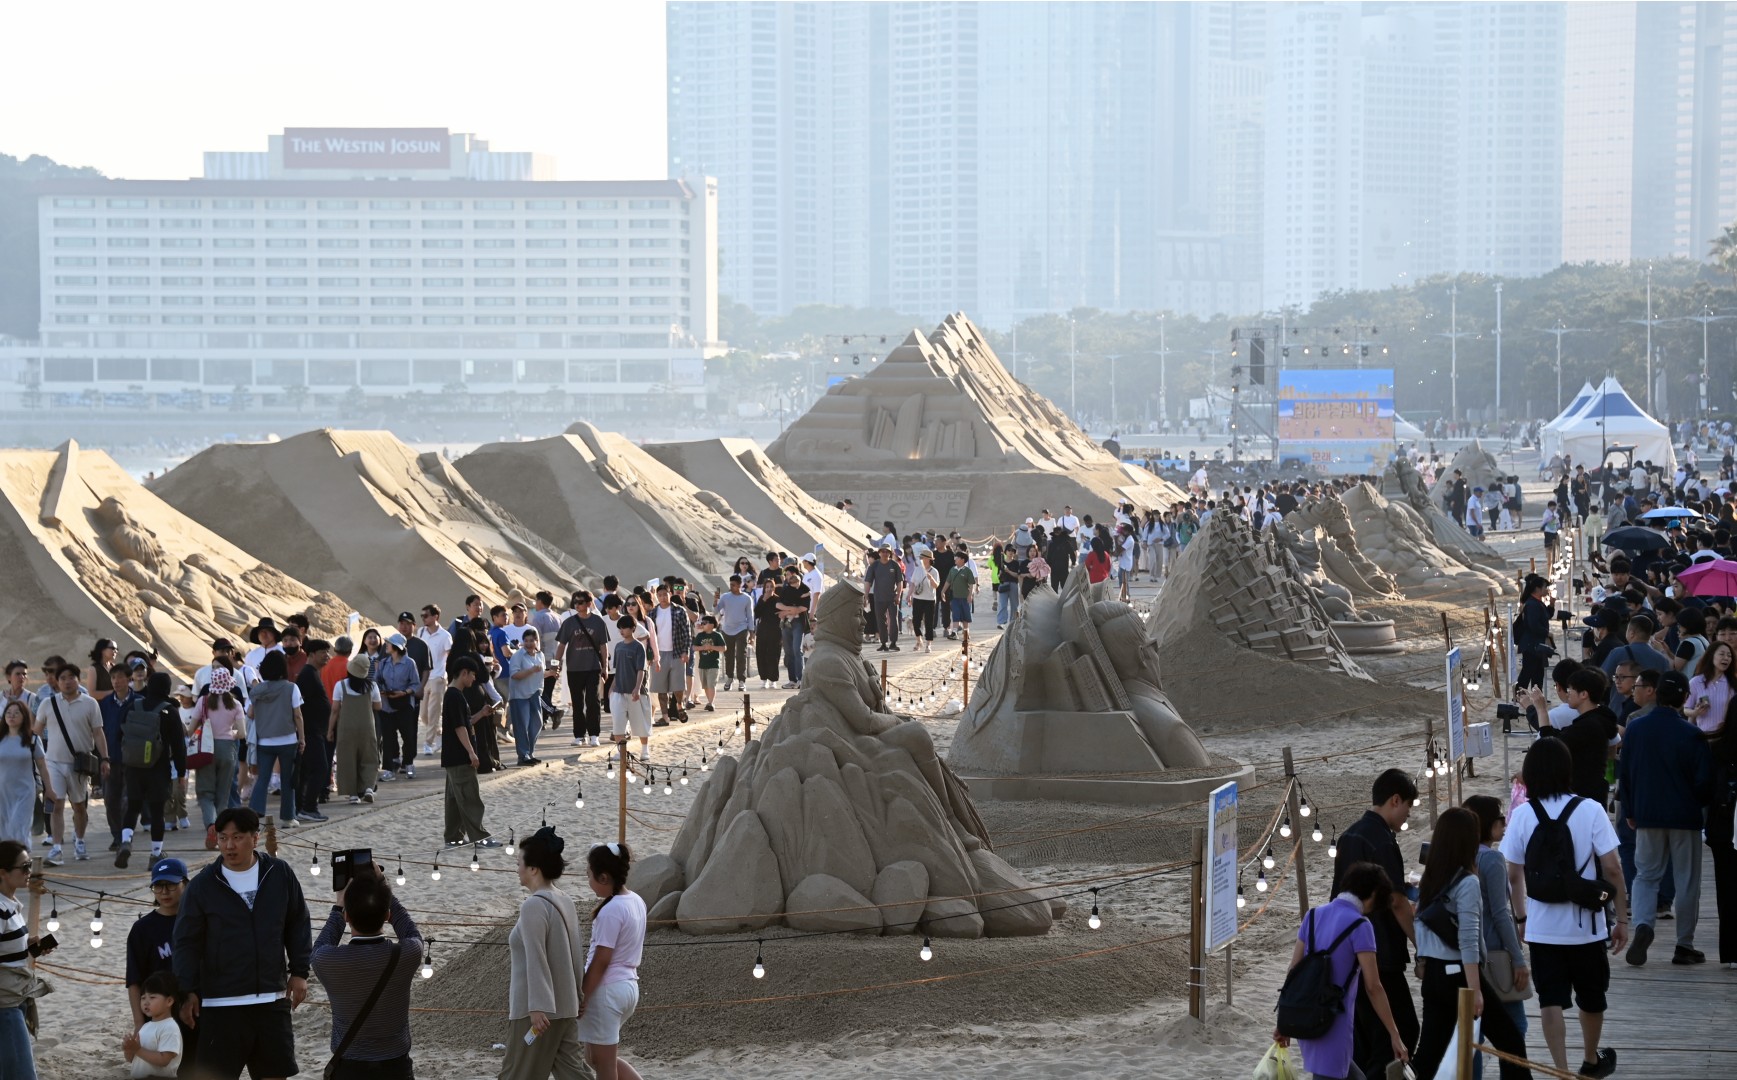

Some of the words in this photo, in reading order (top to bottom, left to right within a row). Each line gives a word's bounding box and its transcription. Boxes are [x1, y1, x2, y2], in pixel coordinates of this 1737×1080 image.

[291, 138, 322, 153] THE
[325, 138, 385, 153] WESTIN
[390, 138, 441, 155] JOSUN
